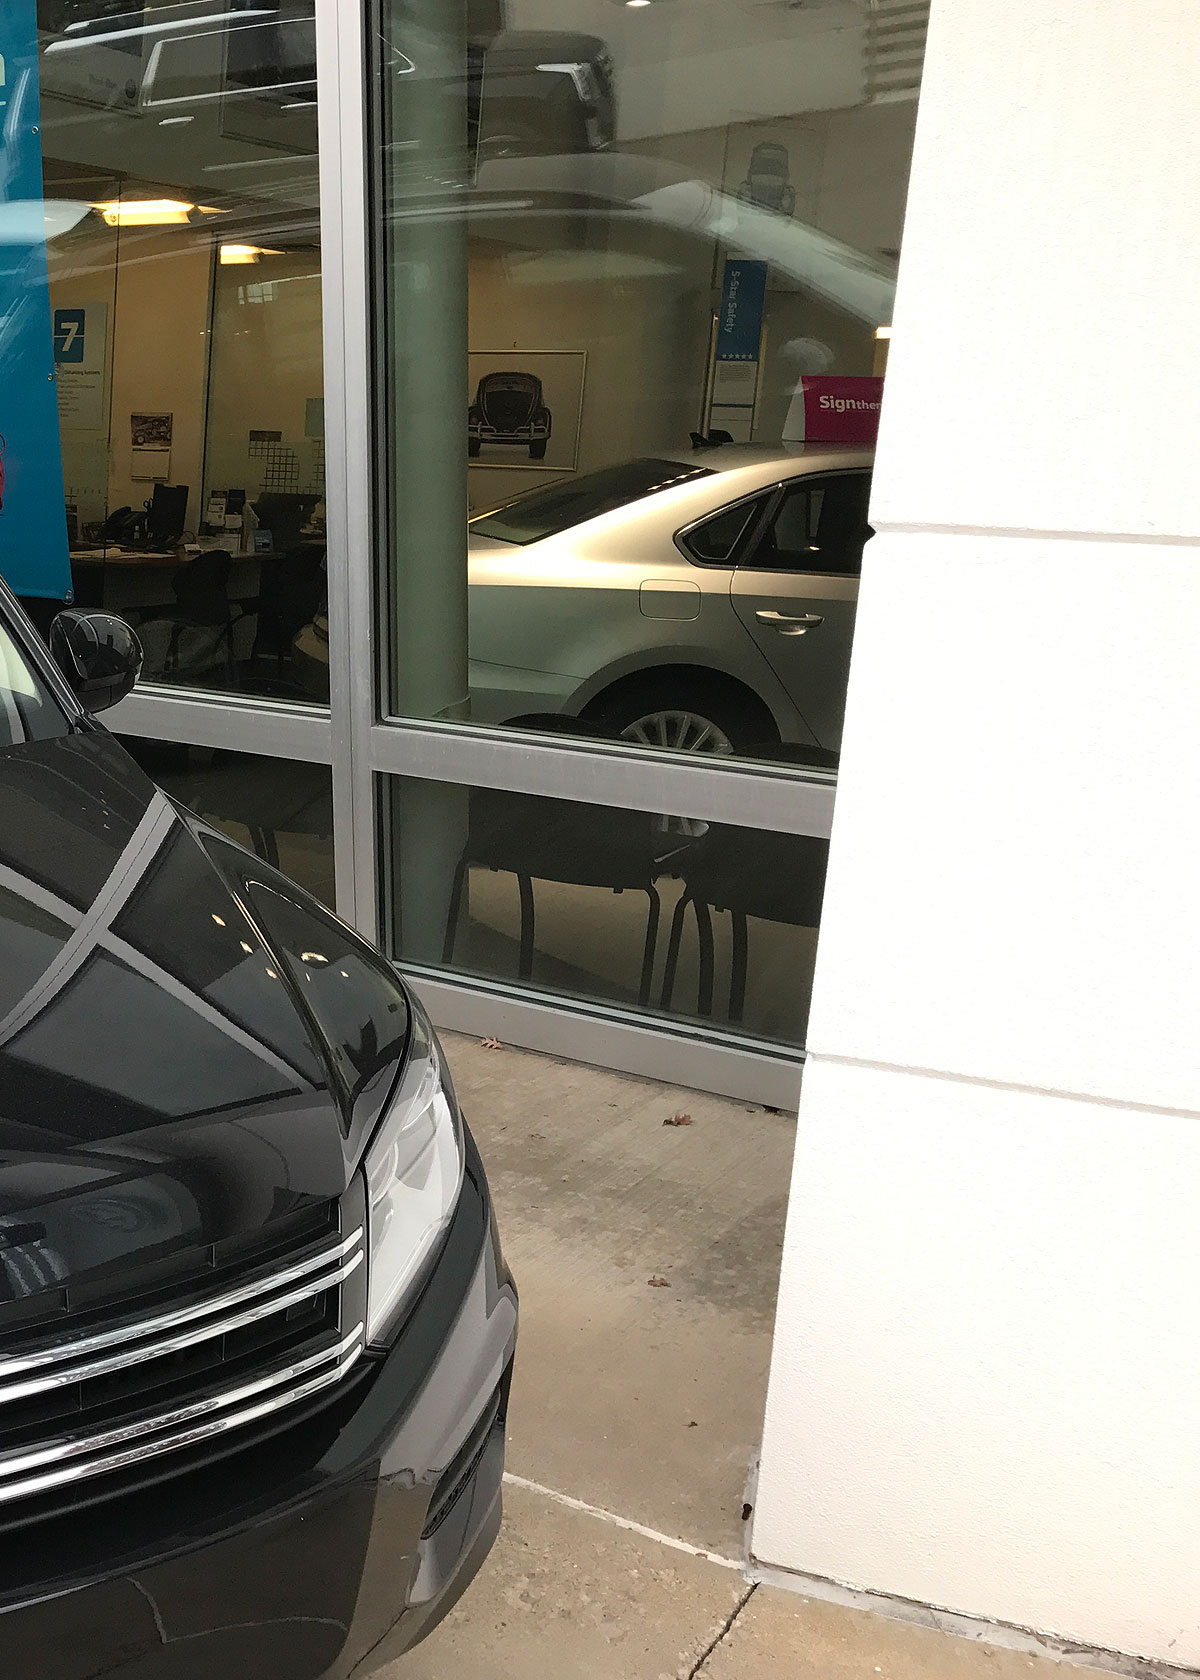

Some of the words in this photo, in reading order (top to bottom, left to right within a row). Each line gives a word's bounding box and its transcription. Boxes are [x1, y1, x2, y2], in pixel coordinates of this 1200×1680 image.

[729, 270, 741, 300] 5-Star
[723, 302, 738, 334] Safety
[61, 322, 79, 352] 7
[819, 395, 856, 413] Sign
